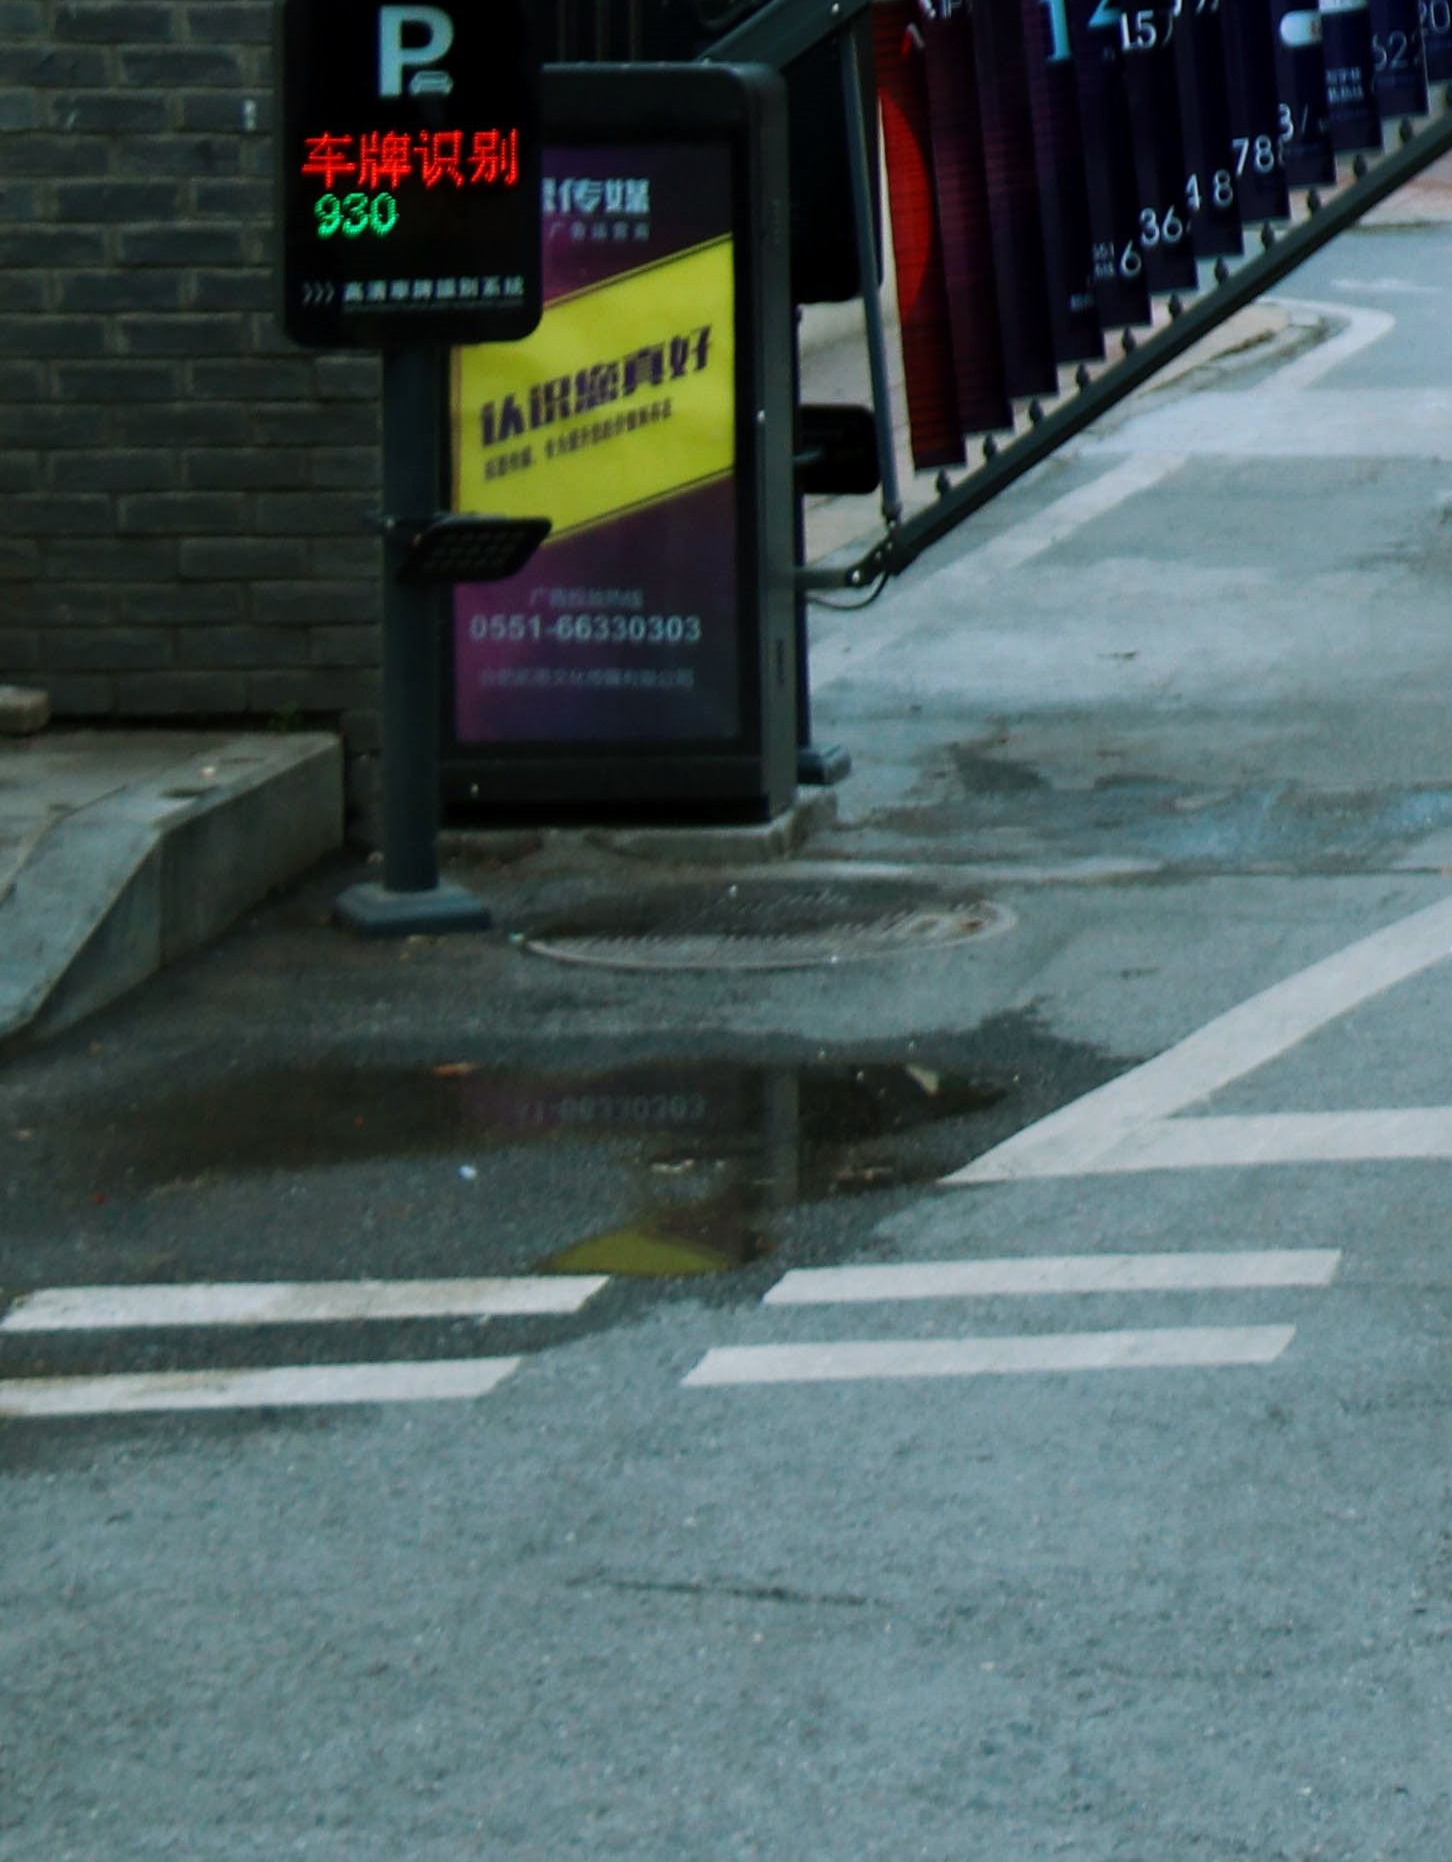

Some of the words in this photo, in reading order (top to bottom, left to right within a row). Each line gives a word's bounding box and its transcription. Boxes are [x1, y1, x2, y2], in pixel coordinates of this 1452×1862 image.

[378, 4, 454, 98] P
[302, 129, 520, 189] 车牌识别
[314, 192, 399, 238] 930
[480, 325, 712, 447] 认识您真好
[469, 614, 702, 644] 0551-66330303
